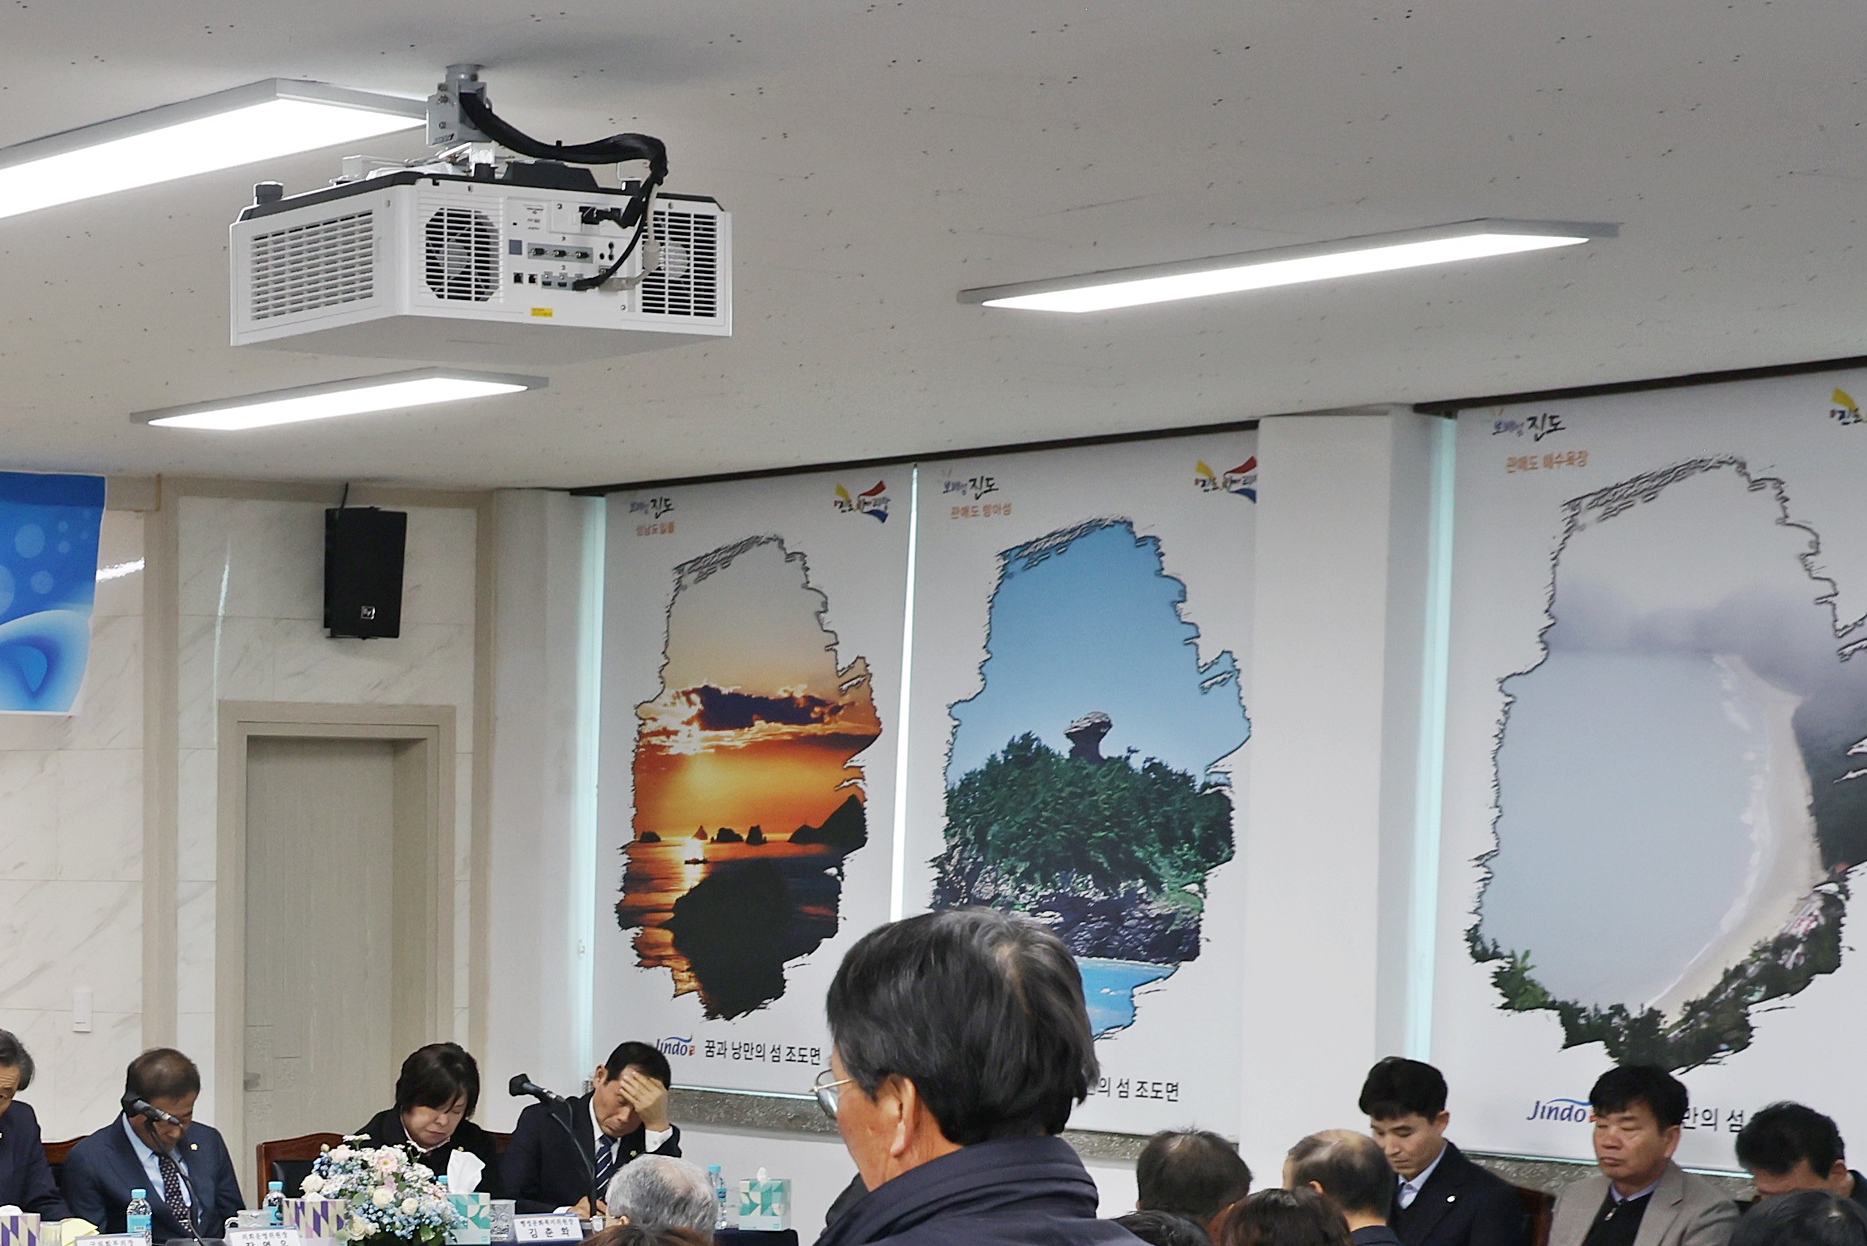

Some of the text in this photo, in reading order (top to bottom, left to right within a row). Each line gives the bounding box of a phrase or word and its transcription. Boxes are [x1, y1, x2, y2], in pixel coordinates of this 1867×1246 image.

[1526, 413, 1566, 442] 진도
[704, 1039, 821, 1066] 꿈과 낭만의 섬 조도면
[1117, 1078, 1130, 1098] 섬
[1135, 1081, 1179, 1102] 조도면
[1527, 1100, 1586, 1123] Jindo
